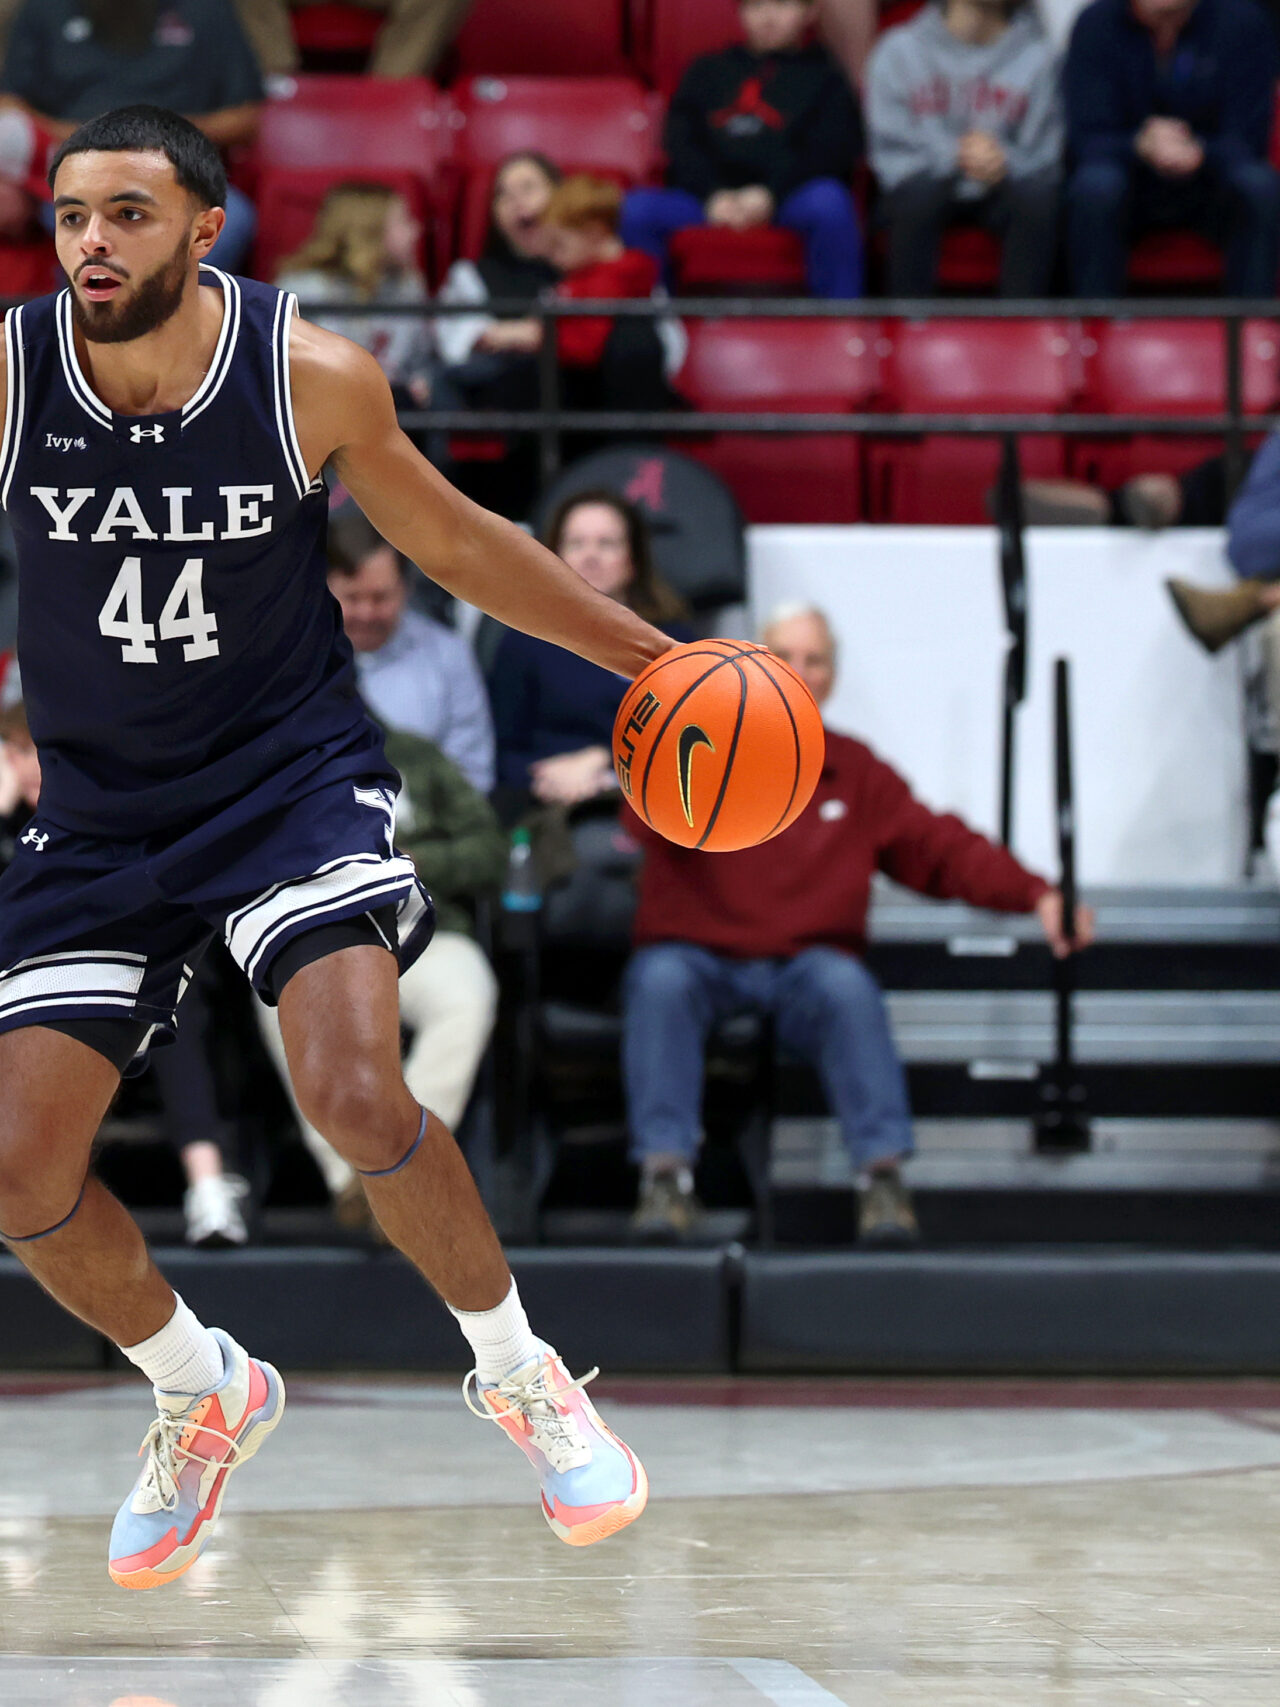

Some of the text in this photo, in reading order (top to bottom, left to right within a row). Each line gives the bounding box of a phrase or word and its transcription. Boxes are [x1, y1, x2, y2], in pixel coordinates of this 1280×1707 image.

[45, 433, 73, 452] Ivy
[30, 484, 274, 543] YALE
[98, 556, 220, 664] 44
[618, 690, 662, 798] ELITE
